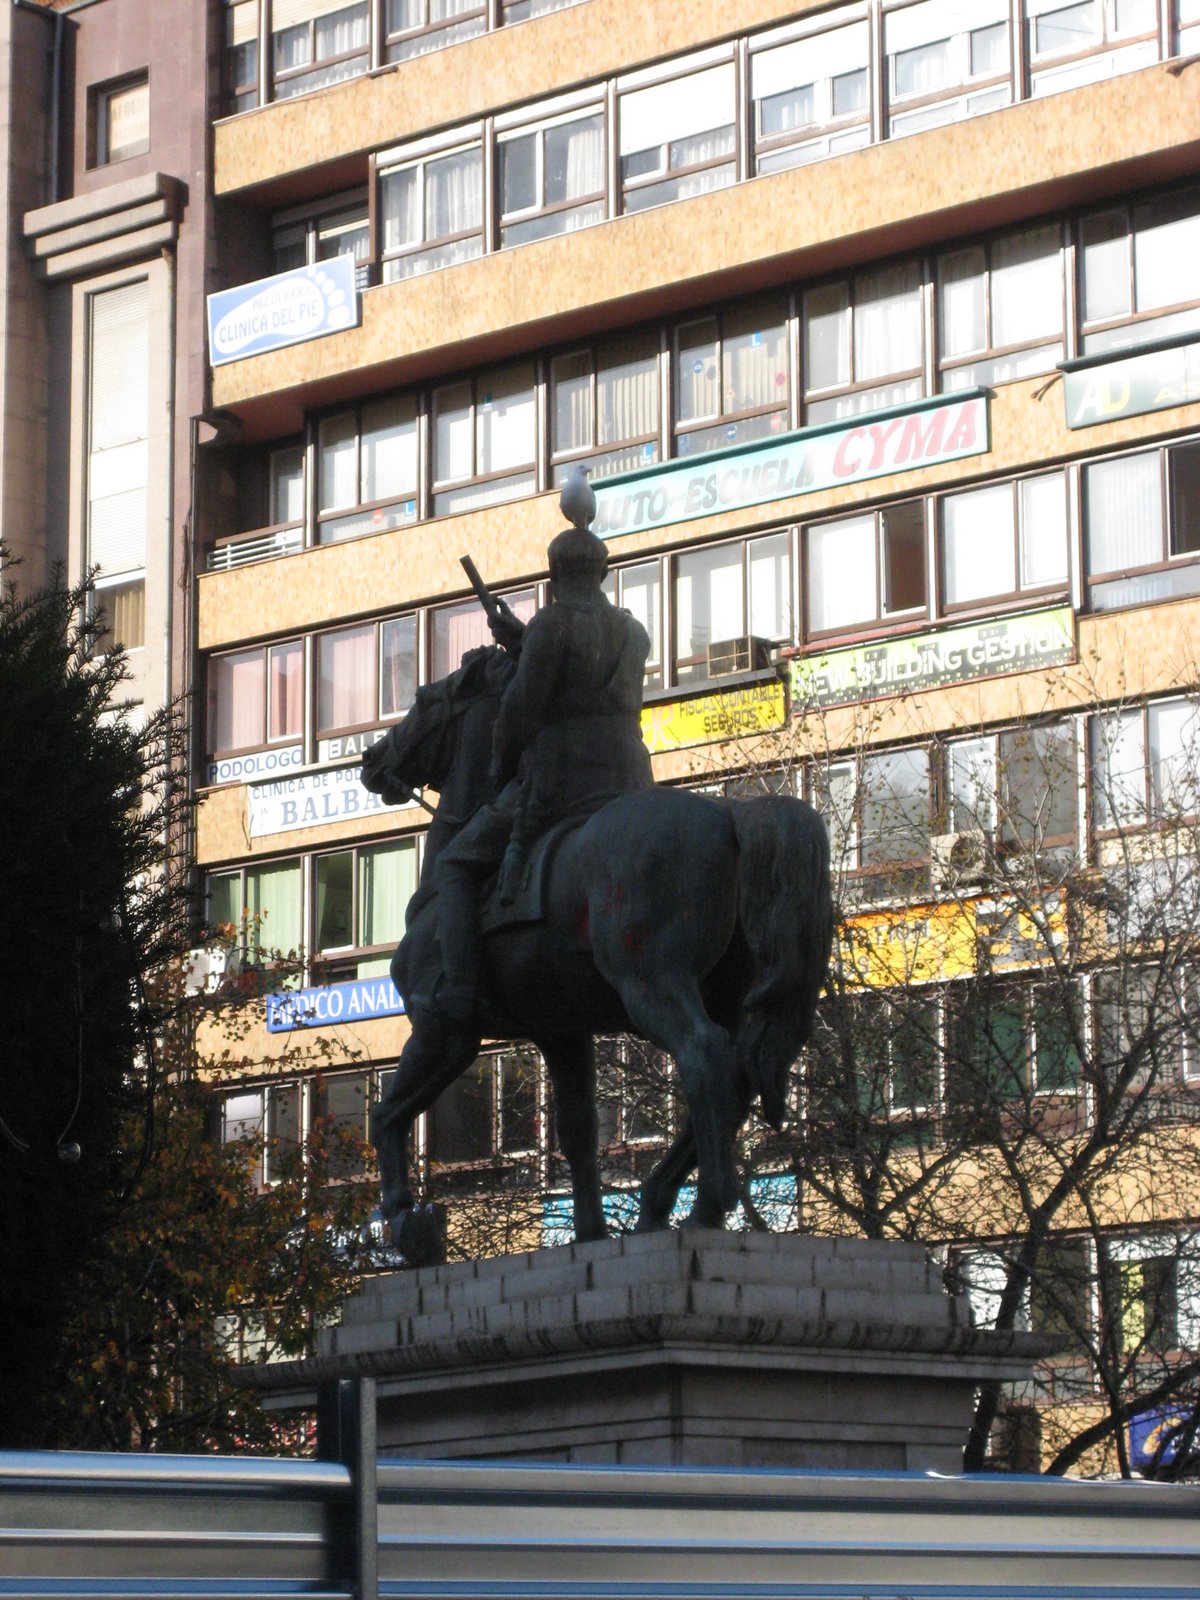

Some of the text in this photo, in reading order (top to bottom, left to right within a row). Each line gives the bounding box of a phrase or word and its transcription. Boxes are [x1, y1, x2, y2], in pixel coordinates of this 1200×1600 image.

[219, 300, 318, 344] CLINICA DEL PIE
[833, 402, 978, 477] CYMA
[797, 664, 855, 698] NEW
[857, 645, 962, 688] BUILDING
[704, 707, 757, 733] SEGUROS
[208, 749, 302, 780] PODOLOGO
[253, 780, 305, 800] CLINICA
[313, 773, 328, 788] DE
[281, 788, 381, 826] BALBA
